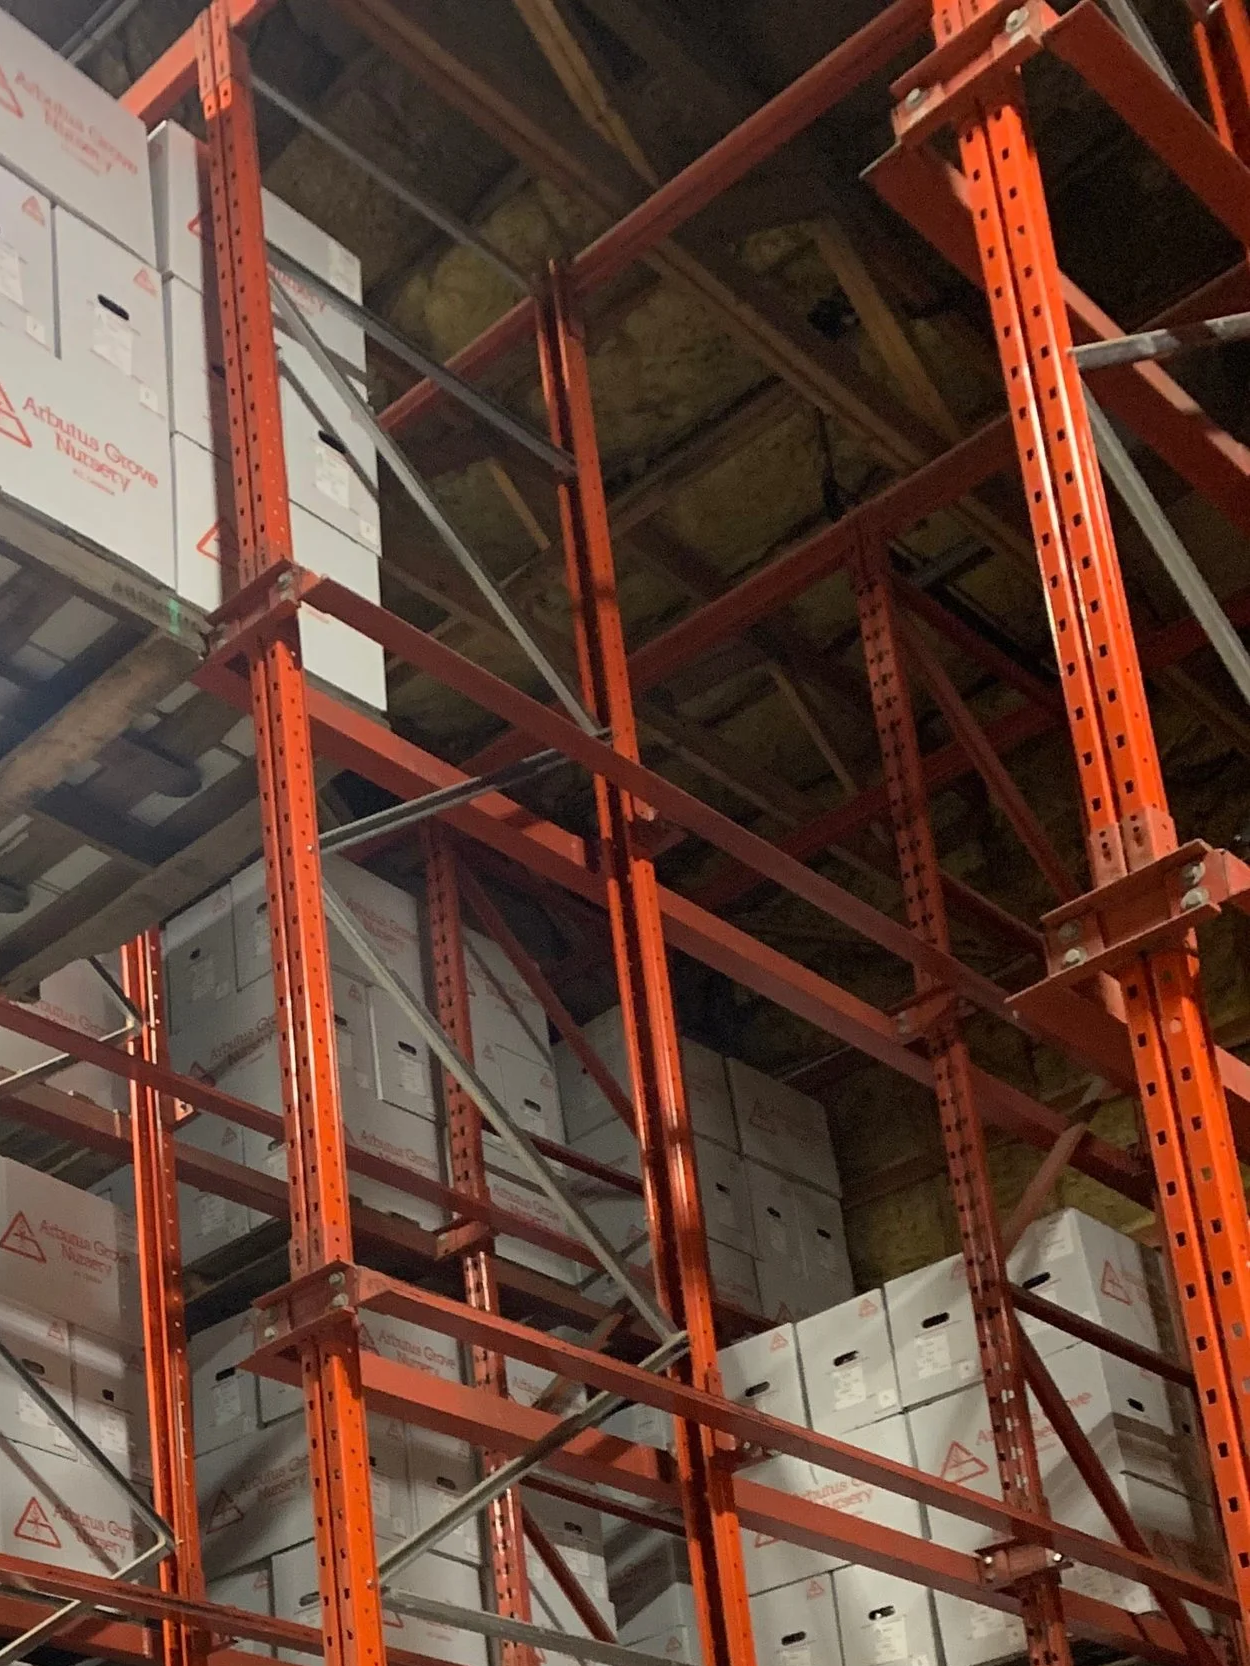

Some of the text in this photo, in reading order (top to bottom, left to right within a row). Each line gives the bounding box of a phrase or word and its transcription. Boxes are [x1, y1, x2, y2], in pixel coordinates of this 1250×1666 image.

[22, 396, 159, 489] Arbutus Grove
[55, 431, 132, 493] Nursery
[39, 1219, 91, 1251] Arbutus
[61, 1243, 113, 1277] Nursery
